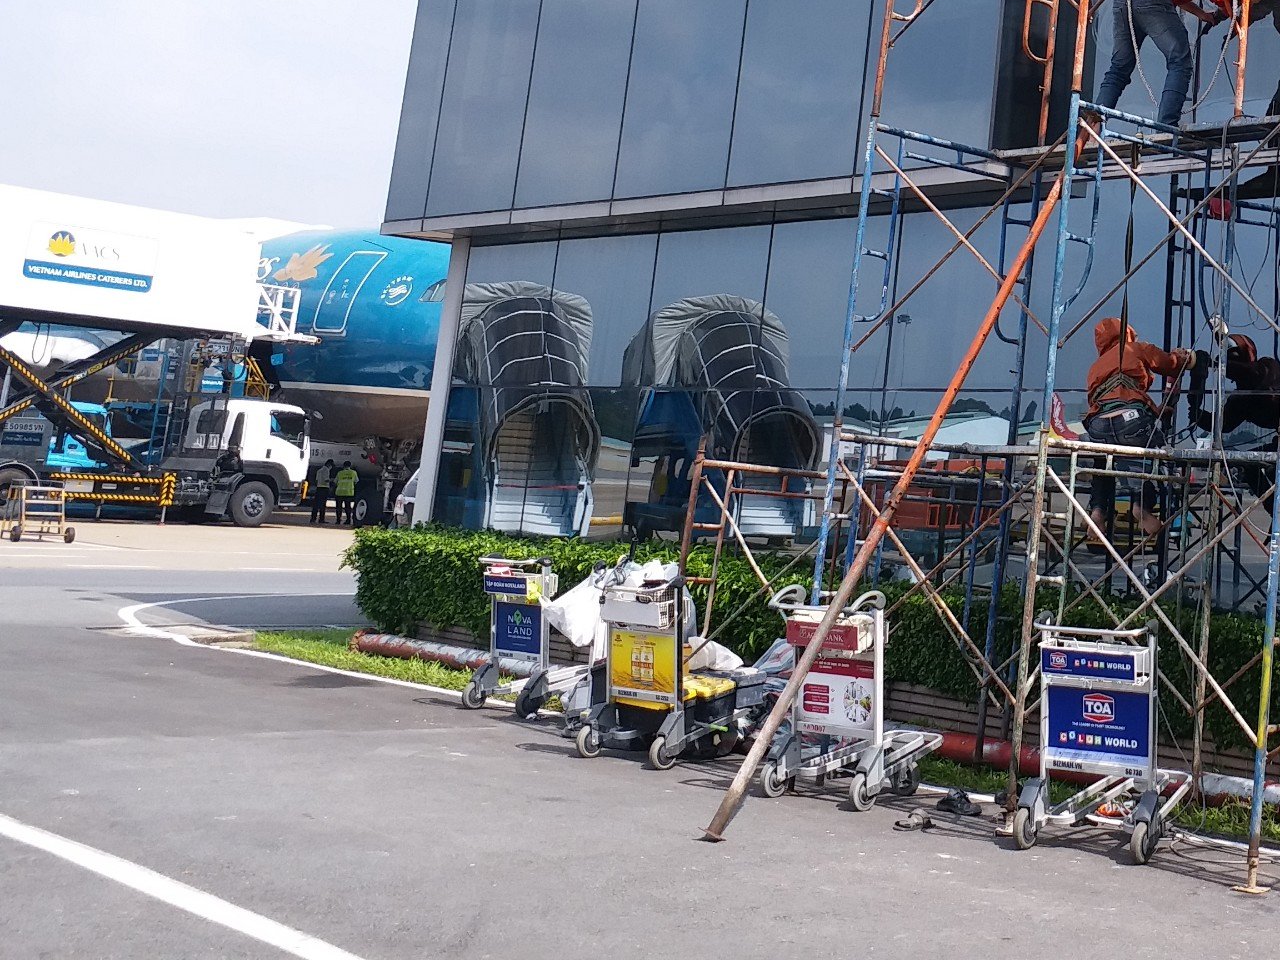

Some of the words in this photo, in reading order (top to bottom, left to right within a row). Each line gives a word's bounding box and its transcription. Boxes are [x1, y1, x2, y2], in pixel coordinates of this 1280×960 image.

[28, 265, 62, 276] VIETNAM
[63, 270, 97, 281] AIRLINES
[97, 274, 132, 285] CATERERS
[133, 279, 148, 288] LTD.
[507, 626, 533, 636] LAND
[1051, 656, 1065, 664] TOA
[1074, 658, 1105, 668] COLOR
[1106, 662, 1131, 670] WORLD
[1085, 701, 1112, 715] TOA
[1060, 730, 1102, 745] COLOR
[1104, 736, 1138, 749] WORLD
